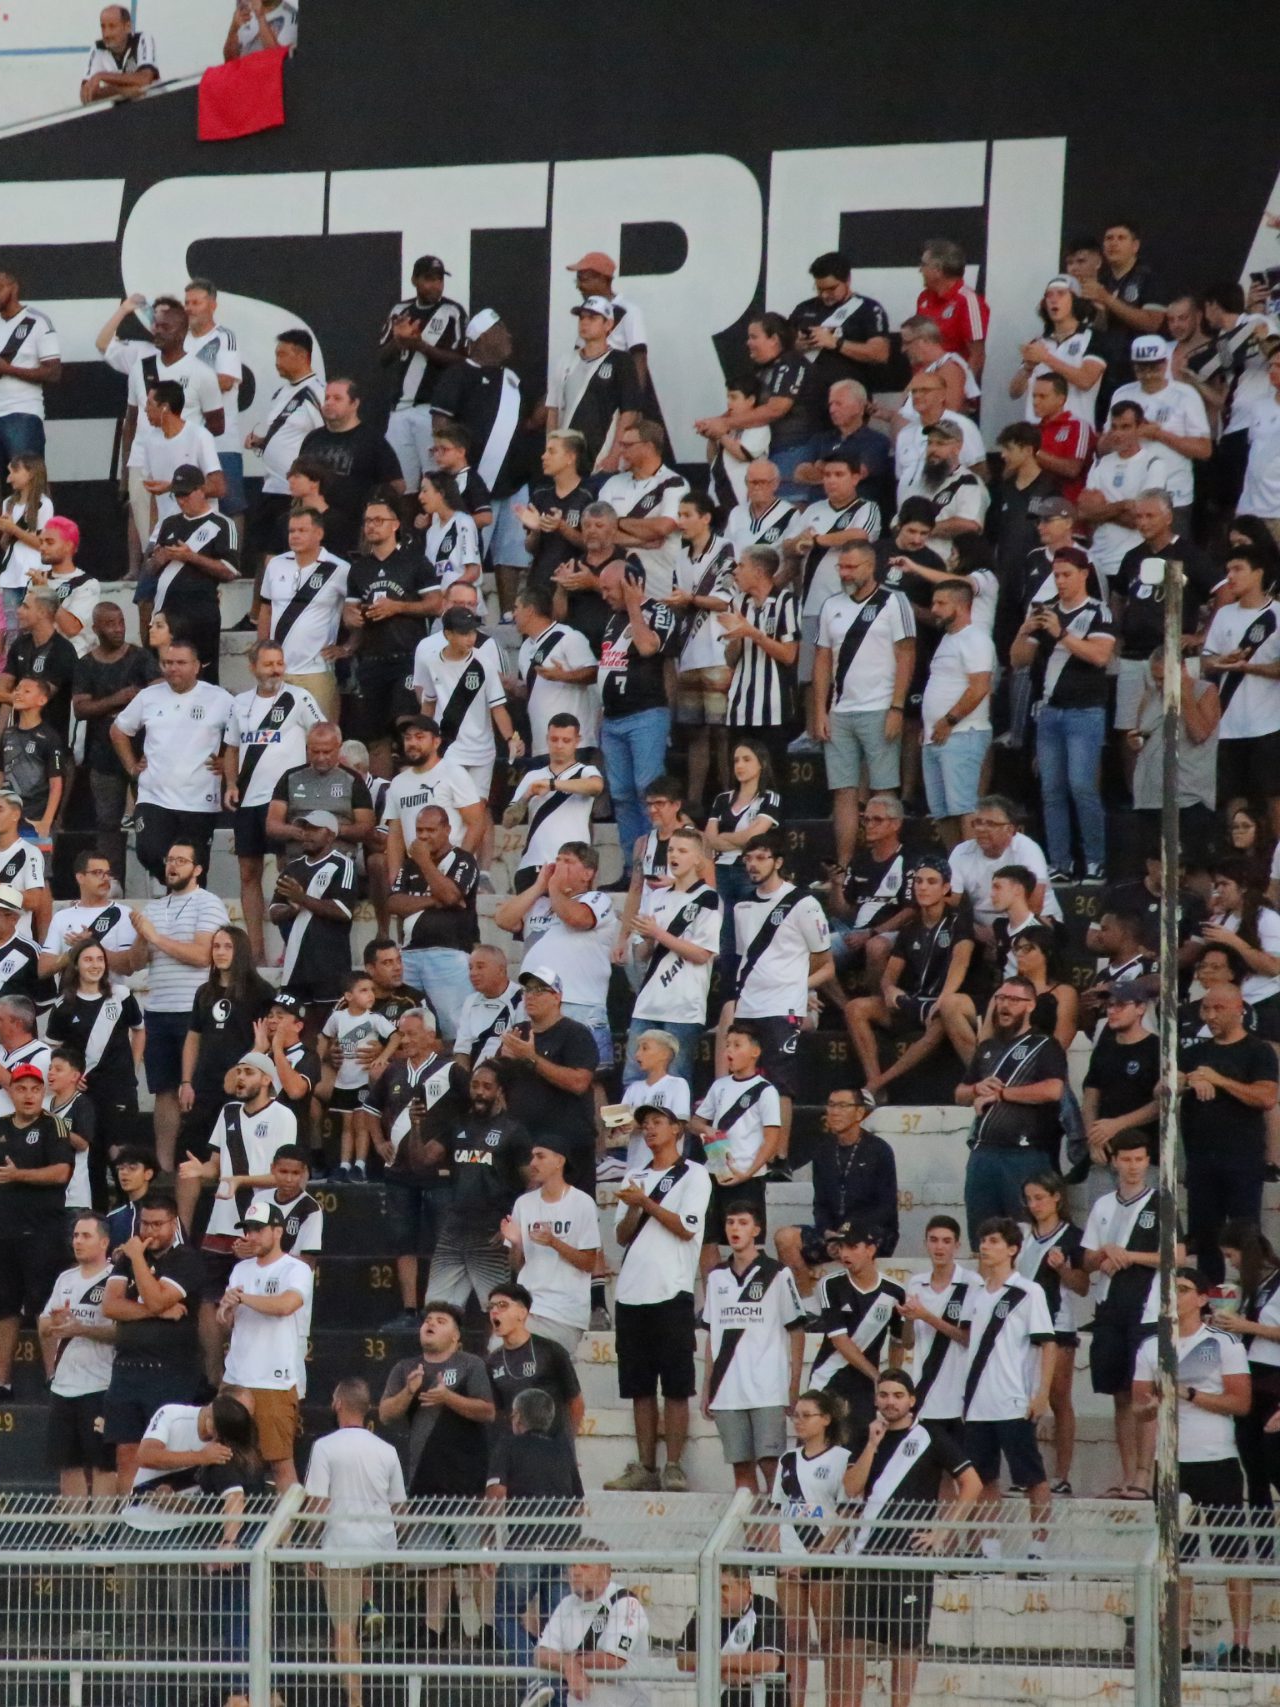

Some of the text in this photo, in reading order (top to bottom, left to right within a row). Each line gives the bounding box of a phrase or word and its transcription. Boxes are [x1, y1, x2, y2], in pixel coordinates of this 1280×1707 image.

[615, 676, 628, 694] 7
[240, 730, 281, 744] CAIXA
[790, 762, 814, 783] 30
[400, 792, 429, 808] PUMA
[901, 1114, 922, 1134] 37
[454, 1150, 493, 1165] CAIXA
[370, 1265, 392, 1288] 32
[720, 1307, 762, 1317] HITACHI
[15, 1341, 34, 1362] 28
[365, 1337, 386, 1361] 33
[592, 1340, 610, 1362] 36
